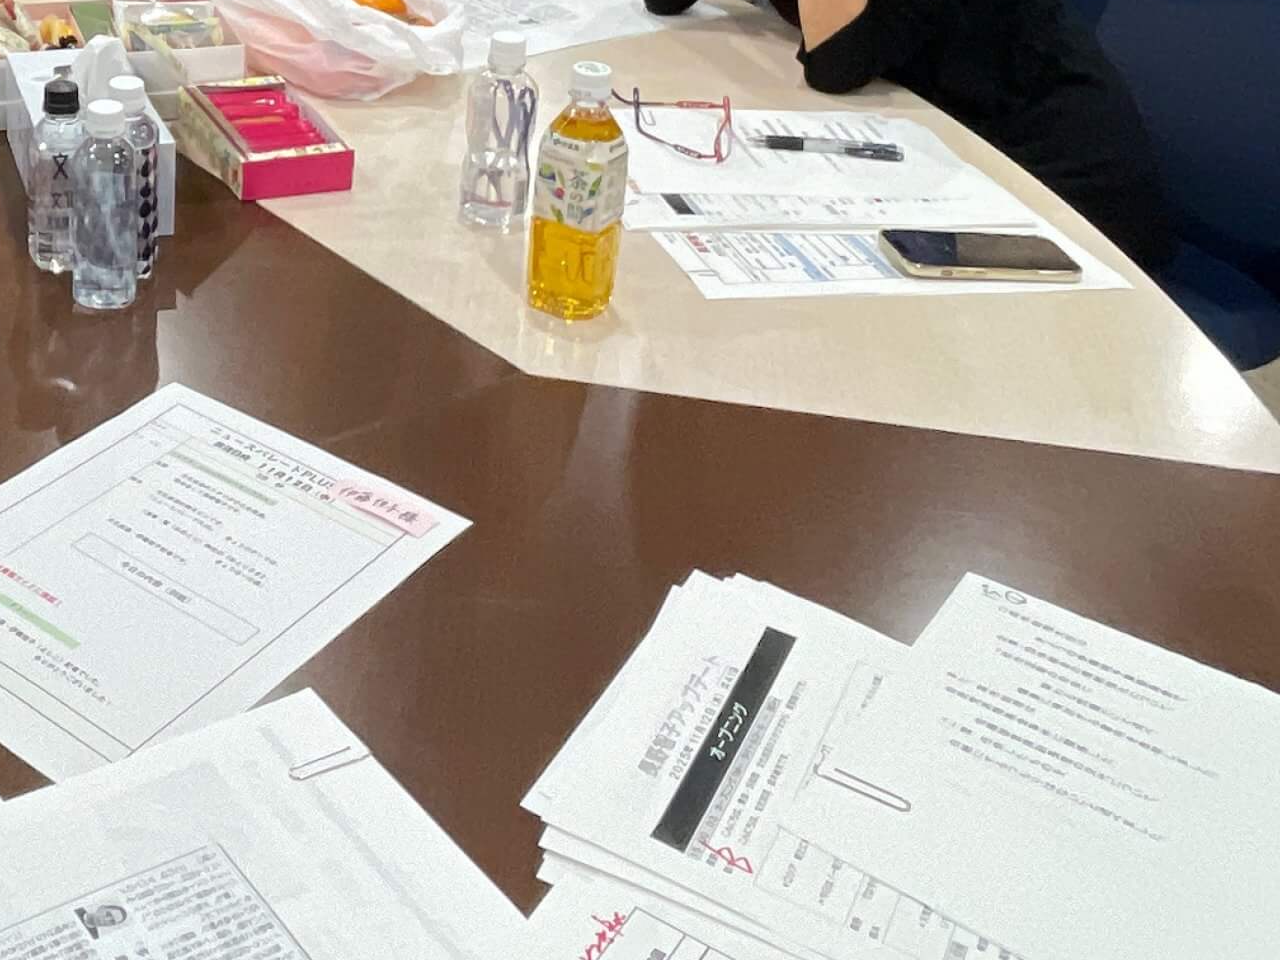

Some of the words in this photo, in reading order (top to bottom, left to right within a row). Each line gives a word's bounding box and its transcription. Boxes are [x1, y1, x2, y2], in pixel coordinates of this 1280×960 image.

[710, 702, 748, 760] オープニング
